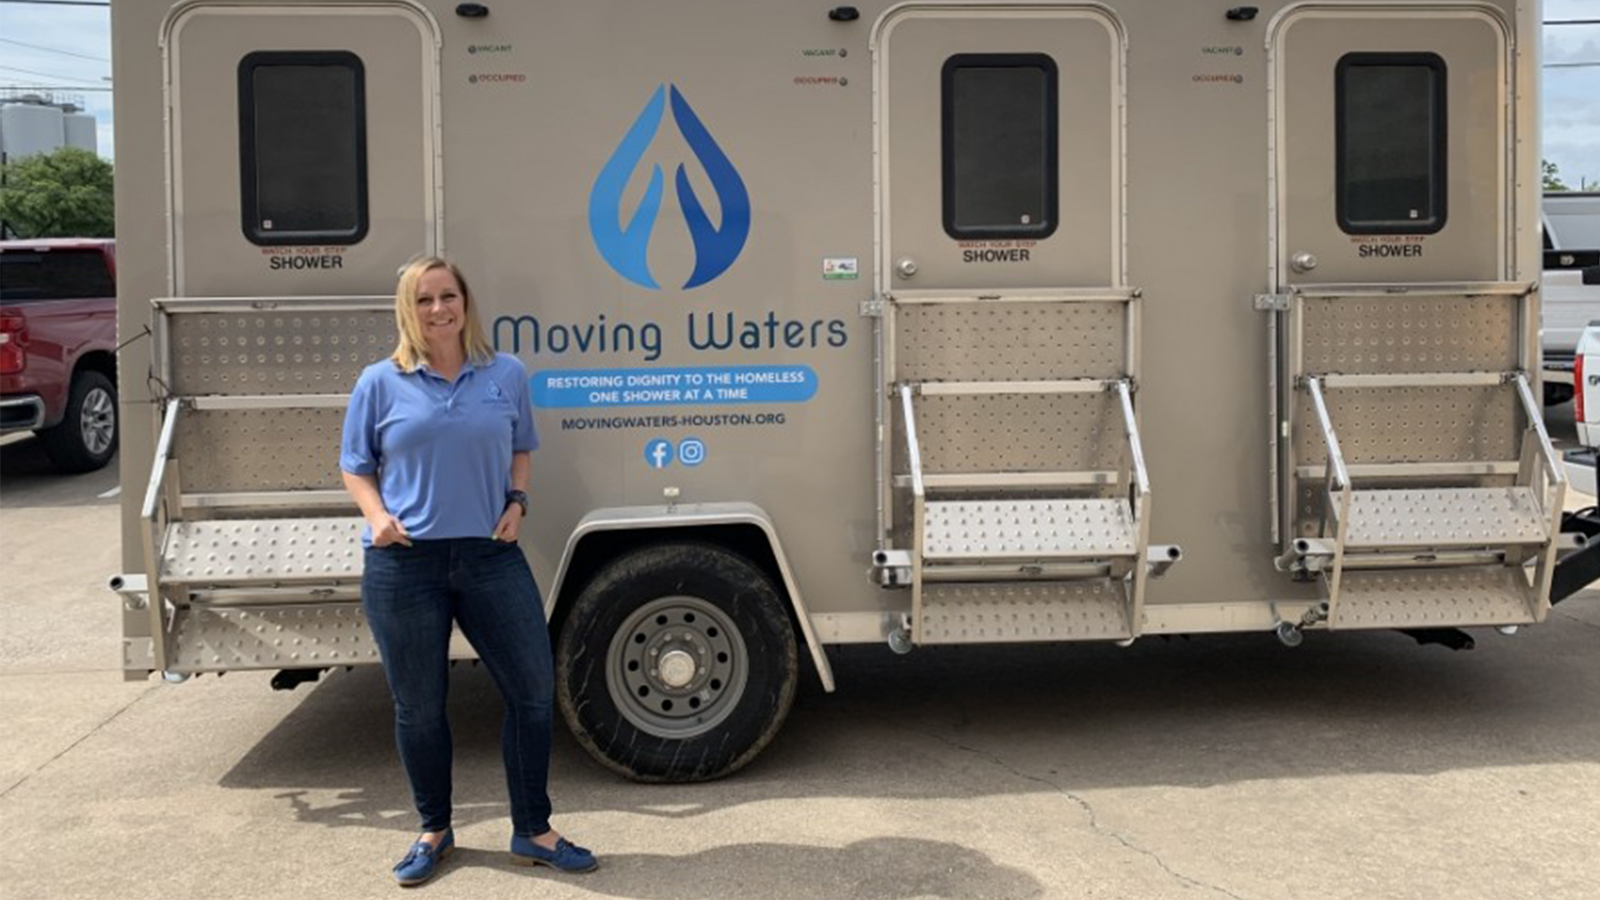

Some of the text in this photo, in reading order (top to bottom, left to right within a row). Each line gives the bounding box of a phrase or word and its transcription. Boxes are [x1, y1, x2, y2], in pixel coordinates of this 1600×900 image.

[963, 248, 1030, 263] SHOWER
[1358, 244, 1422, 257] SHOWER
[269, 255, 343, 270] SHOWER
[493, 310, 848, 361] Moving Waters
[546, 371, 805, 389] RESTORING DIGNITY TO THE HOMELESS
[588, 387, 748, 403] ONE SHOWER AT A TIME
[561, 413, 786, 430] MOVINGWATERS-HOUSTON.ORG
